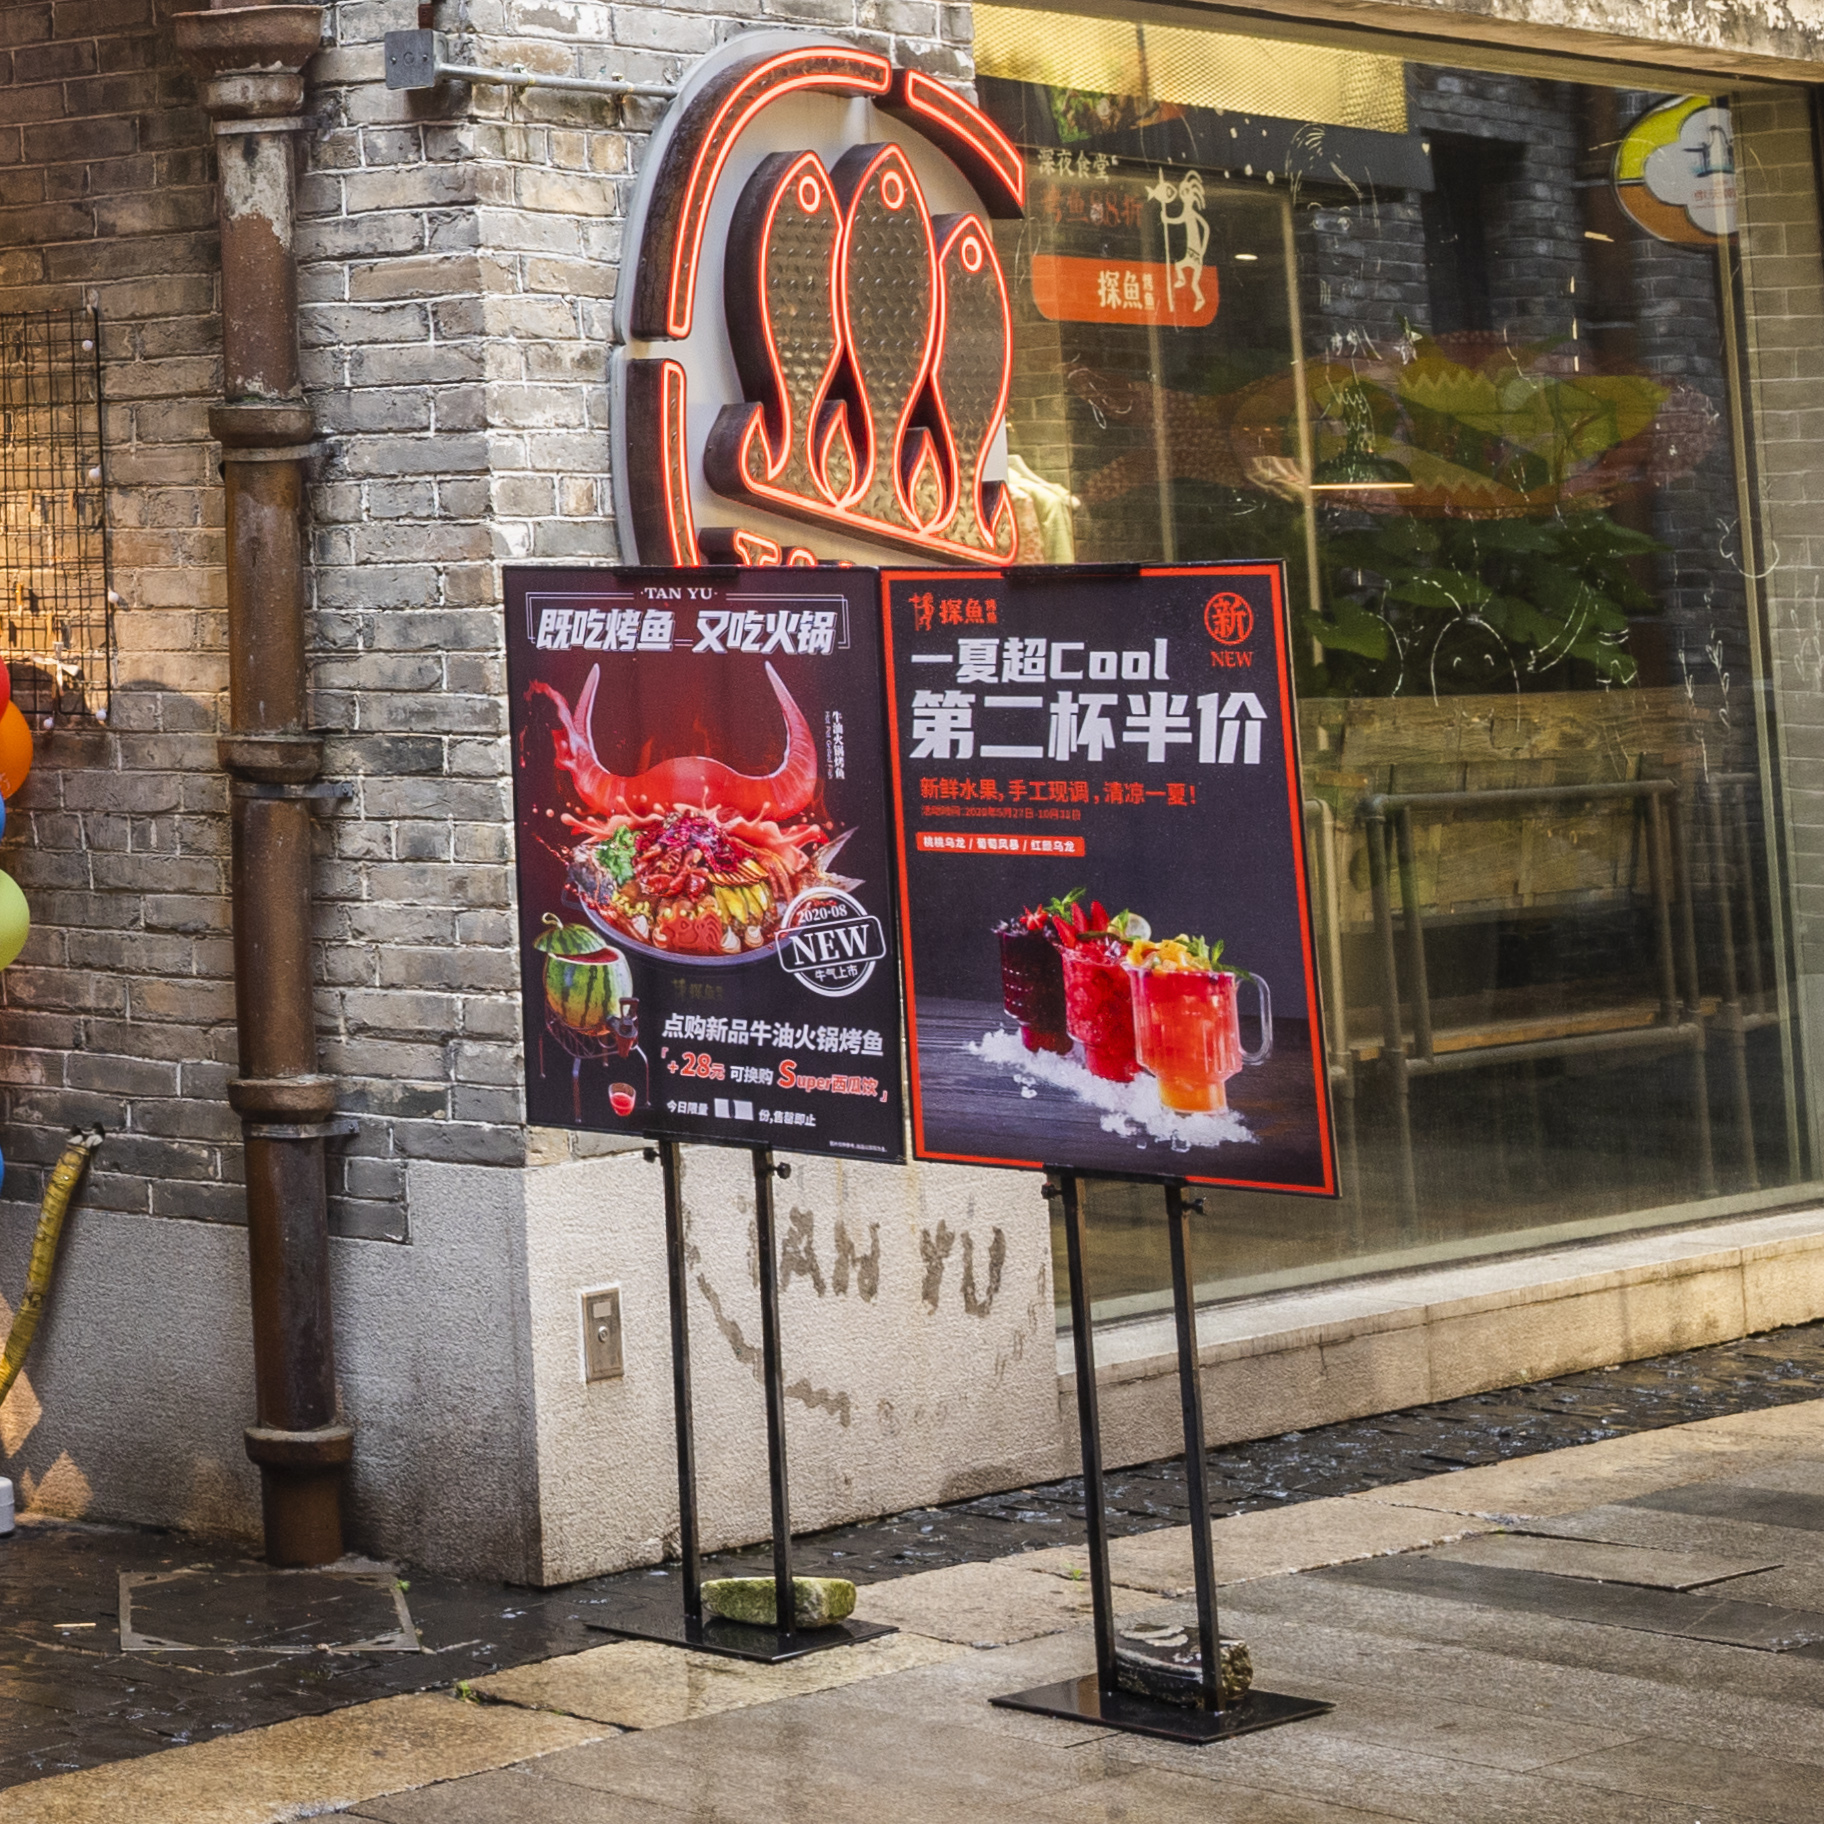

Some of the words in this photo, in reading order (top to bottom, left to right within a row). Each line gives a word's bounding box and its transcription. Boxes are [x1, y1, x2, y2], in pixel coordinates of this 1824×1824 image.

[644, 587, 682, 600] TAN
[687, 587, 714, 600] YU
[535, 607, 676, 653] 既吃烤鱼
[690, 609, 839, 656] 又吃火锅
[1210, 597, 1248, 642] 新
[910, 636, 1171, 684] 一夏超Cool
[1210, 651, 1254, 668] NEW
[908, 689, 1269, 765] 第二杯半价
[789, 924, 870, 966] NEW
[814, 964, 859, 982] 牛气上市
[661, 1012, 885, 1057] 点购新品牛油火锅烤鱼
[730, 1065, 774, 1086] 可换购
[666, 1100, 709, 1117] 今日限量
